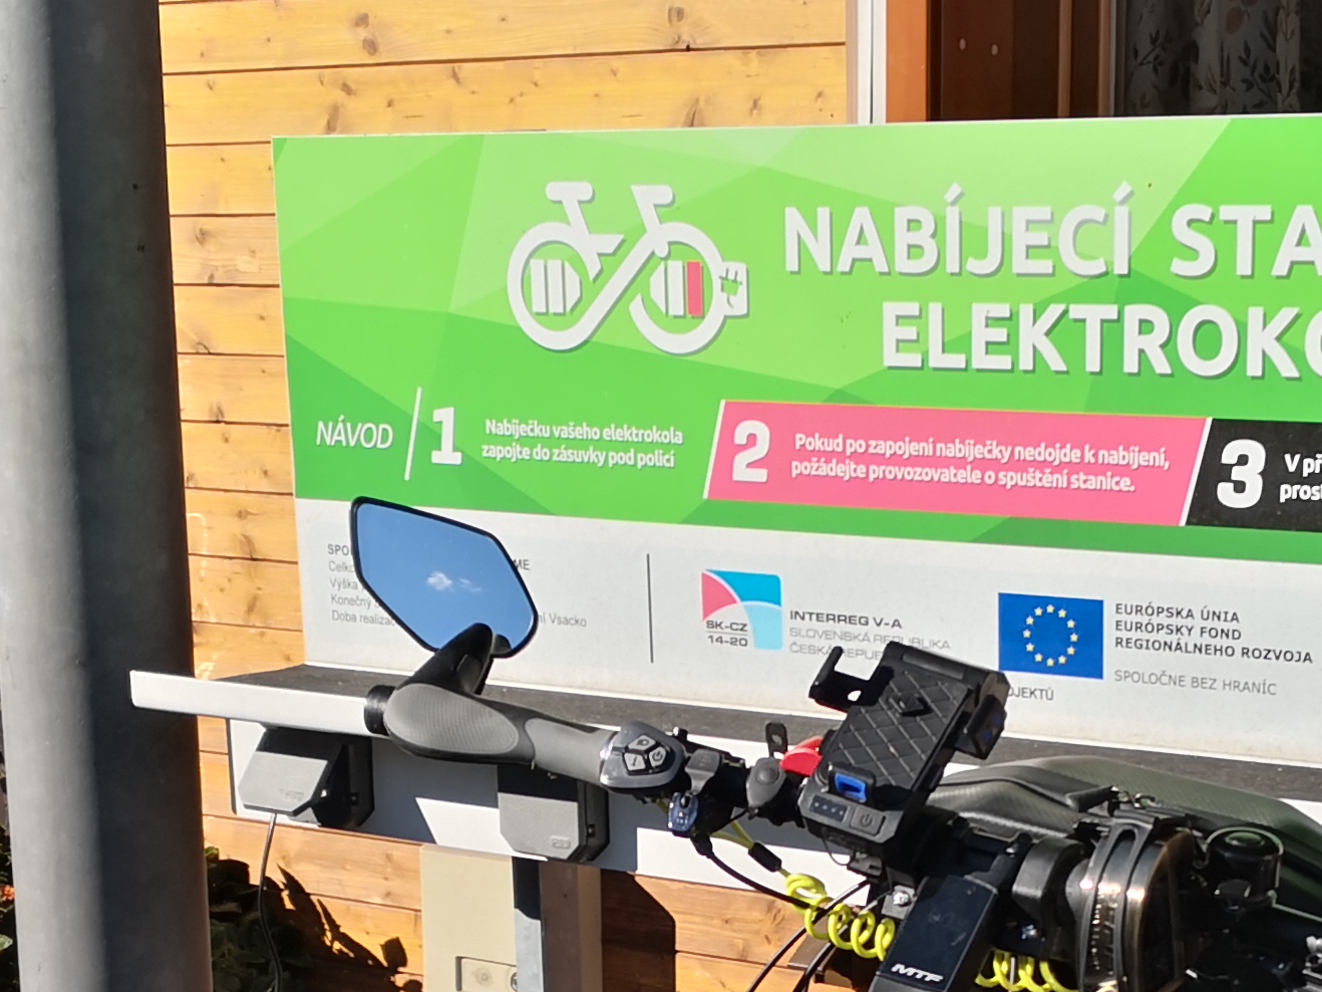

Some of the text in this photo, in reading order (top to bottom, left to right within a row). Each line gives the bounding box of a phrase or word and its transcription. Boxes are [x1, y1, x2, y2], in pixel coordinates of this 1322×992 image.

[784, 181, 1133, 278] NABÍJECÍ
[316, 415, 394, 450] NÁVOD
[431, 407, 463, 466] 1
[485, 418, 683, 445] Nabíječku vašeho elektrokola
[481, 443, 530, 462] zapojte
[532, 443, 550, 462] do
[553, 445, 606, 468] zásuvky
[608, 447, 634, 468] pod
[732, 419, 770, 483] 2
[795, 433, 1170, 471] Pokud po zapojení nabíječky nedojde k nabíjení,
[1284, 453, 1301, 473] V
[791, 457, 1136, 492] požádejte provozovatele o spuštění stanice.
[1217, 439, 1266, 509] 3
[327, 543, 350, 556] SPO
[332, 609, 357, 623] Doba
[548, 612, 588, 629] Vsacko
[789, 610, 903, 630] INTERREG V-A
[1115, 602, 1240, 623] EURÓPSKA ÚNIA
[706, 619, 749, 633] SK-CZ
[789, 626, 870, 644] SLOVENSKÁ
[1115, 619, 1242, 641] EURÓPSKY FOND
[707, 634, 749, 648] 14-20
[1115, 636, 1313, 664] REGIONÁLNEHO ROZVOJA
[1114, 669, 1277, 696] SPOLOČNE BEZ HRANÍC
[890, 963, 944, 982] MTF
